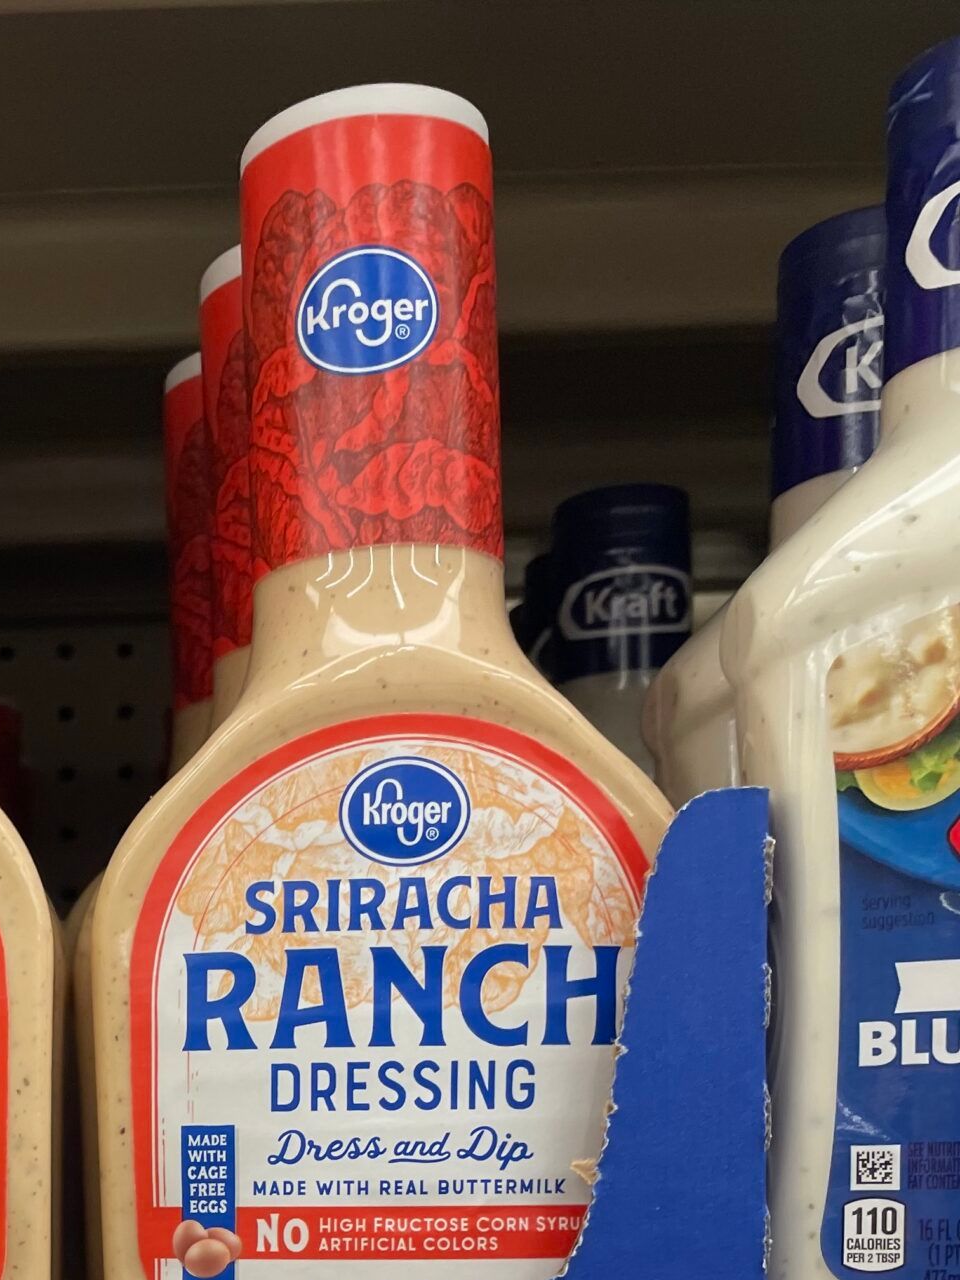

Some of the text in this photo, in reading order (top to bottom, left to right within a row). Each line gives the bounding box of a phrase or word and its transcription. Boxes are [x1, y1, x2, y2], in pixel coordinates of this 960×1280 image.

[307, 278, 428, 346] Kroger
[584, 580, 678, 623] Kraft
[363, 778, 452, 846] Kroger
[245, 875, 563, 935] SRIRACHA
[182, 943, 622, 1053] RANCH
[270, 1059, 536, 1113] DRESSING
[187, 1134, 227, 1147] MADE
[267, 1125, 534, 1171] Dress and Dip
[187, 1150, 227, 1163] WITH
[187, 1166, 227, 1180] CAGE
[189, 1183, 226, 1197] FREE
[253, 1178, 567, 1196] MADE WITH REAL BUTTERMILK
[189, 1200, 228, 1214] EGGS
[319, 1215, 580, 1233] HIGH FRUCTOSE CORN SYRU
[852, 1206, 898, 1235] 110
[256, 1213, 309, 1253] NO
[318, 1235, 499, 1252] ARTIFICIAL COLORS
[847, 1238, 901, 1251] CALORIES
[847, 1252, 901, 1264] PER TBSP
